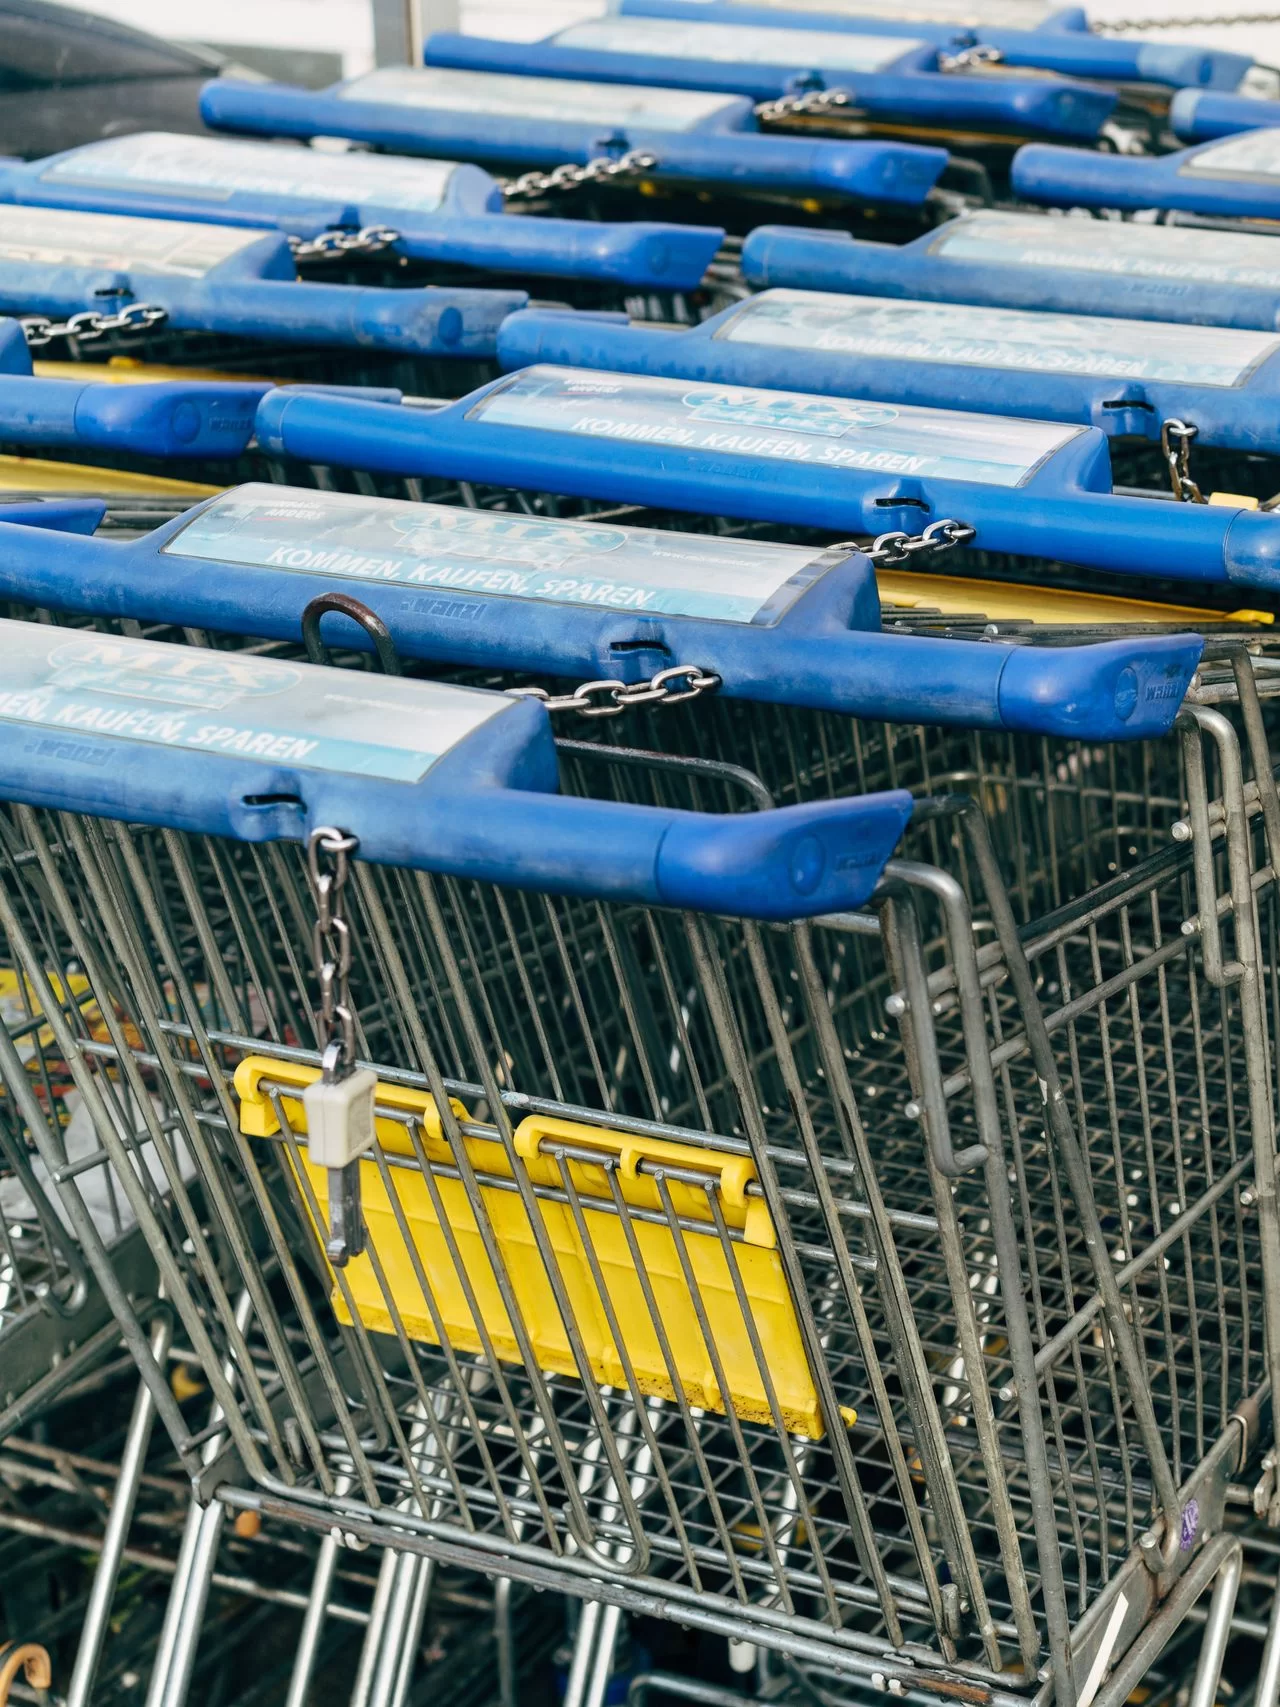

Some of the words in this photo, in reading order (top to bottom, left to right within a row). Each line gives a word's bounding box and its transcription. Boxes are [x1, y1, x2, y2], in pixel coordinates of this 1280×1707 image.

[571, 416, 696, 444] KOMMEN,
[700, 432, 810, 460] KAUFEN,
[817, 446, 929, 472] SPAREN
[266, 545, 402, 580] KOMMEN,
[407, 563, 530, 594] KAUFEN,
[535, 578, 656, 606] SPAREN
[53, 703, 186, 742] KAUFEN,
[187, 725, 321, 760] SPAREN
